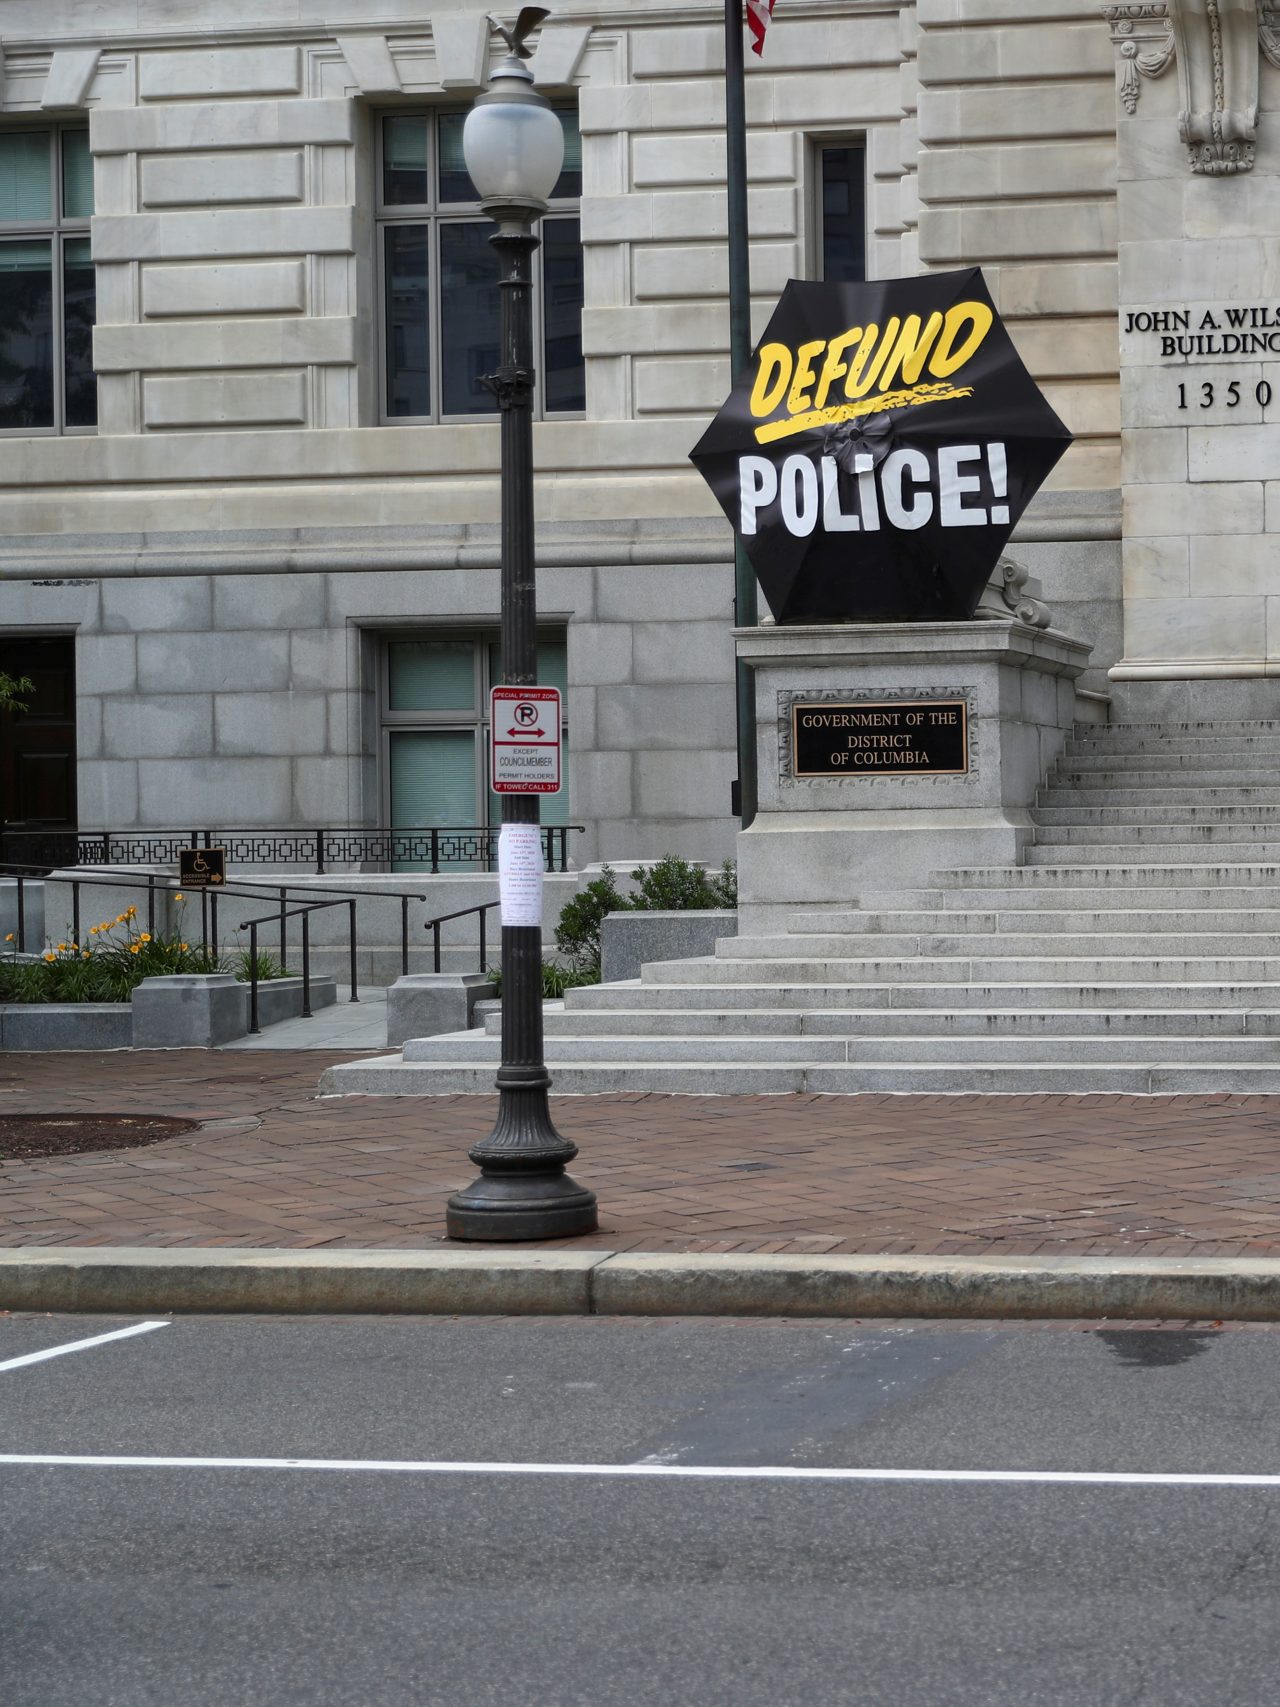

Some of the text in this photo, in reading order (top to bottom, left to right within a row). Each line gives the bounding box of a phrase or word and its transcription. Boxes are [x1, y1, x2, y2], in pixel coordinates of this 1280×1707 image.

[1125, 310, 1190, 333] JOHN
[1199, 310, 1221, 330] A.
[750, 301, 993, 417] DEFUND
[739, 442, 1010, 537] POLICE!
[802, 712, 957, 727] GOVERNMENT OF THE
[848, 734, 912, 748] DISTRICT
[500, 756, 553, 767] COUNCILMEMBER
[831, 751, 930, 765] OF COLUMBIA
